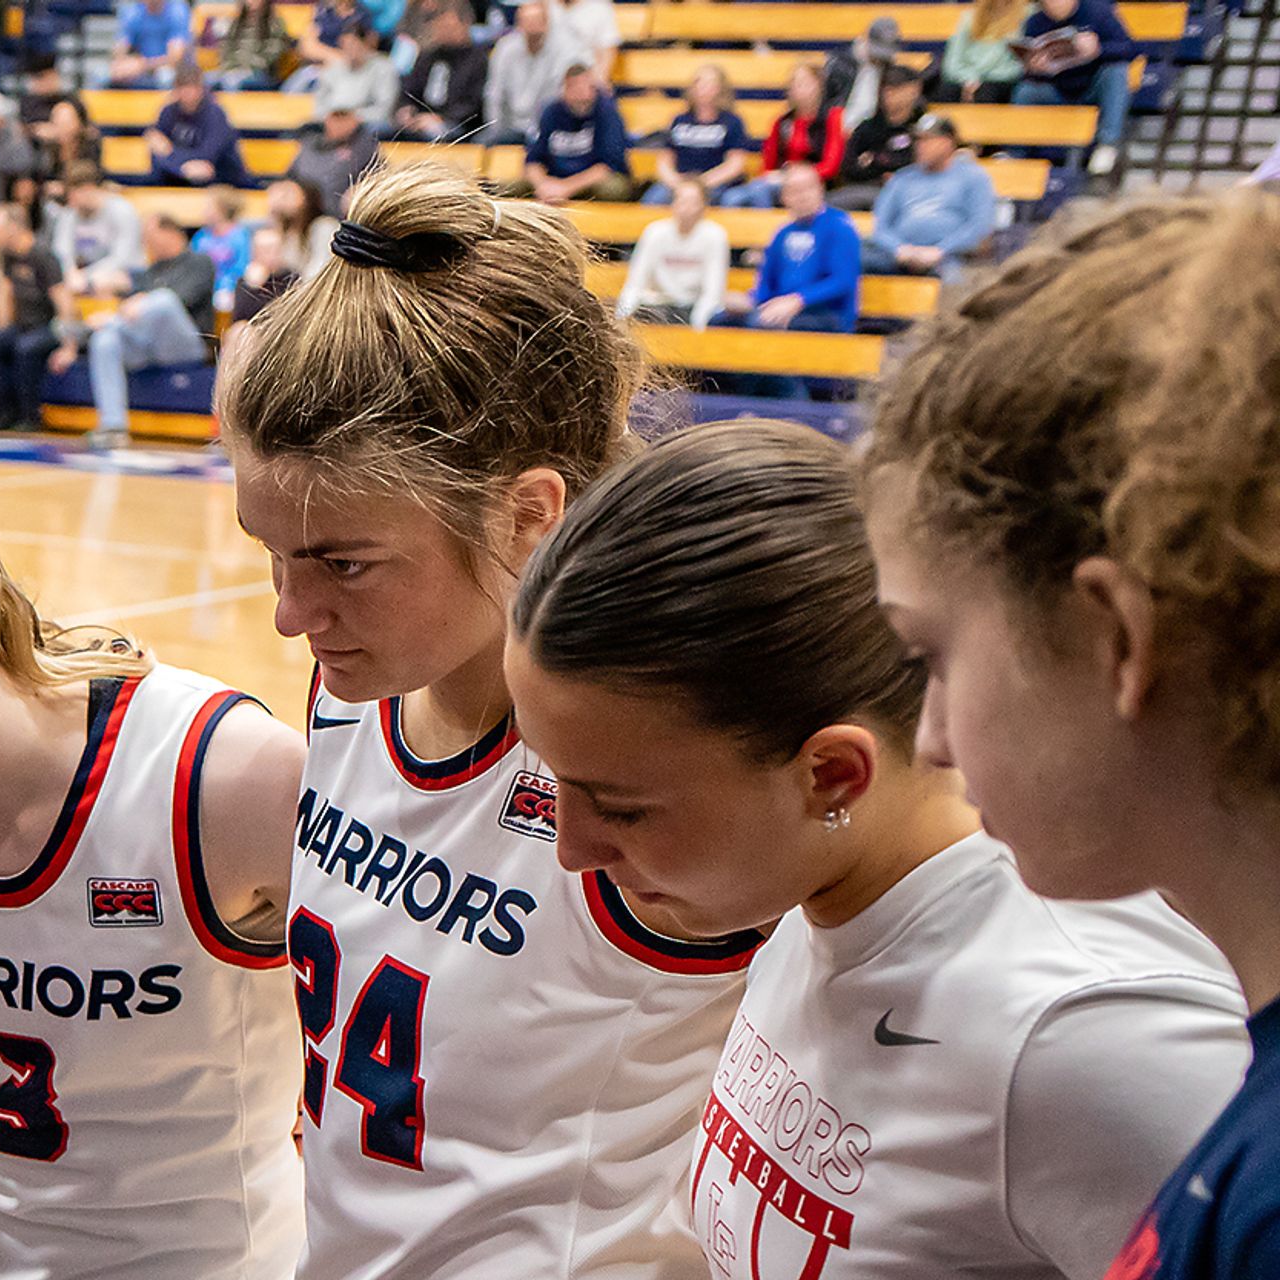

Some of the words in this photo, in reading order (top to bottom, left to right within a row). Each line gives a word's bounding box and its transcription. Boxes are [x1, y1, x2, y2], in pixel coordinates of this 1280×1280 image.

[518, 774, 558, 794] CASC
[90, 881, 155, 891] CASCADE
[93, 893, 155, 912] CCC
[295, 786, 539, 957] WARRIORS
[287, 904, 431, 1172] 24
[718, 1013, 872, 1195] ARRIORS
[704, 1103, 837, 1241] SKETBALL
